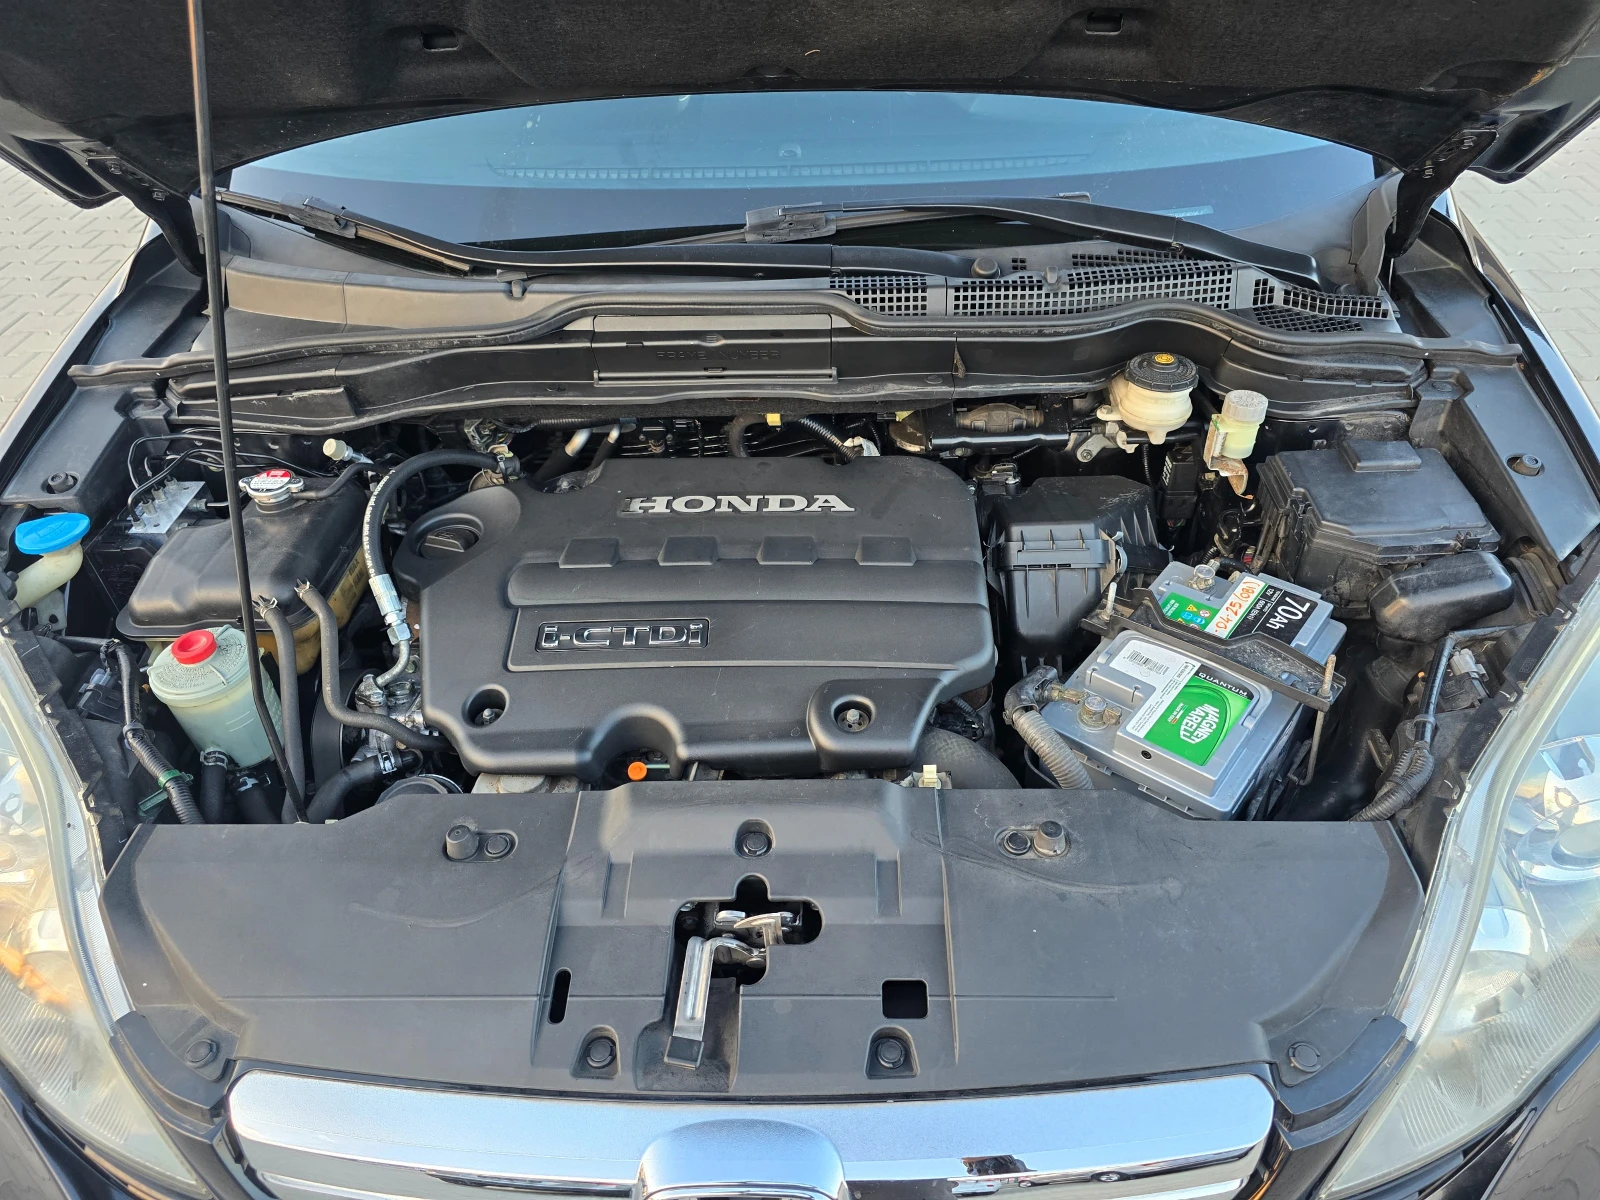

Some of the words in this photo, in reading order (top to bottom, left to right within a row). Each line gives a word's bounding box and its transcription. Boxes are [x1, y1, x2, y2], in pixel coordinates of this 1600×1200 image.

[656, 351, 707, 360] FRAME
[719, 350, 780, 360] NUMBER
[622, 494, 856, 514] HONDA
[1265, 596, 1311, 630] 70Ah
[542, 623, 703, 647] i-CTDi
[1198, 672, 1248, 696] QUANTUM
[1190, 704, 1220, 744] MAGNETI
